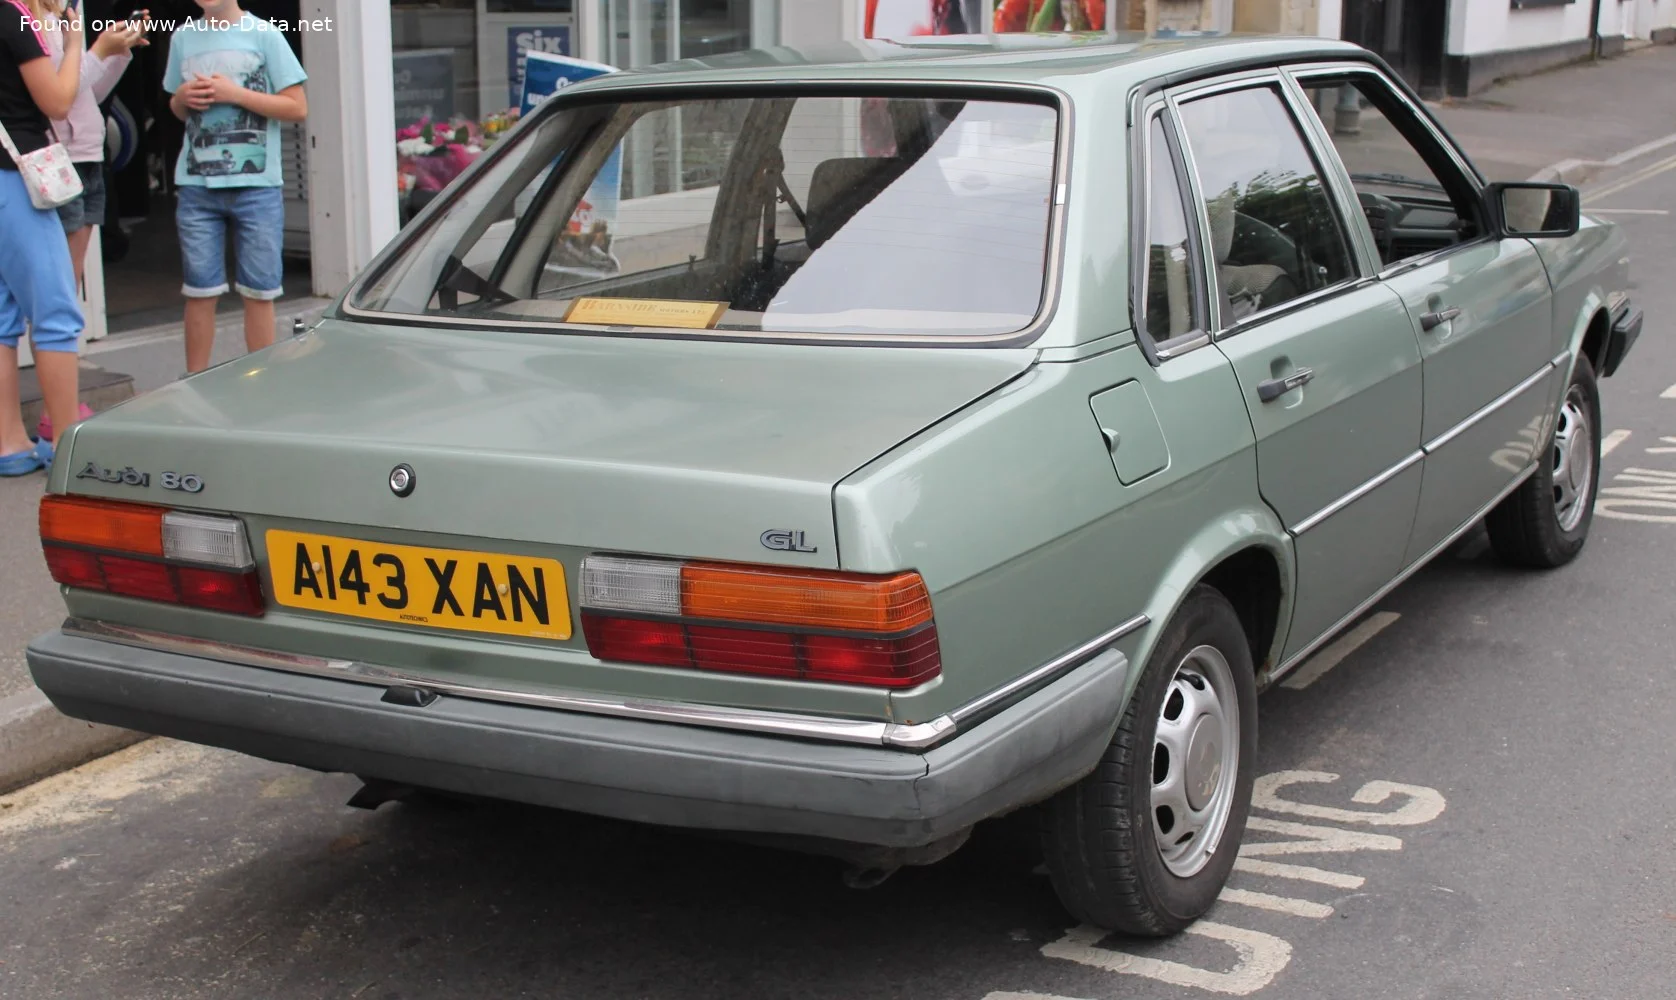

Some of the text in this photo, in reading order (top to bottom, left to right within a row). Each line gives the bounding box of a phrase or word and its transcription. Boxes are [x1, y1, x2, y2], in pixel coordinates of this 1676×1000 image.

[515, 29, 563, 54] Six
[76, 462, 205, 493] Audi 80
[760, 529, 818, 553] GL
[294, 542, 550, 625] A143 XAN
